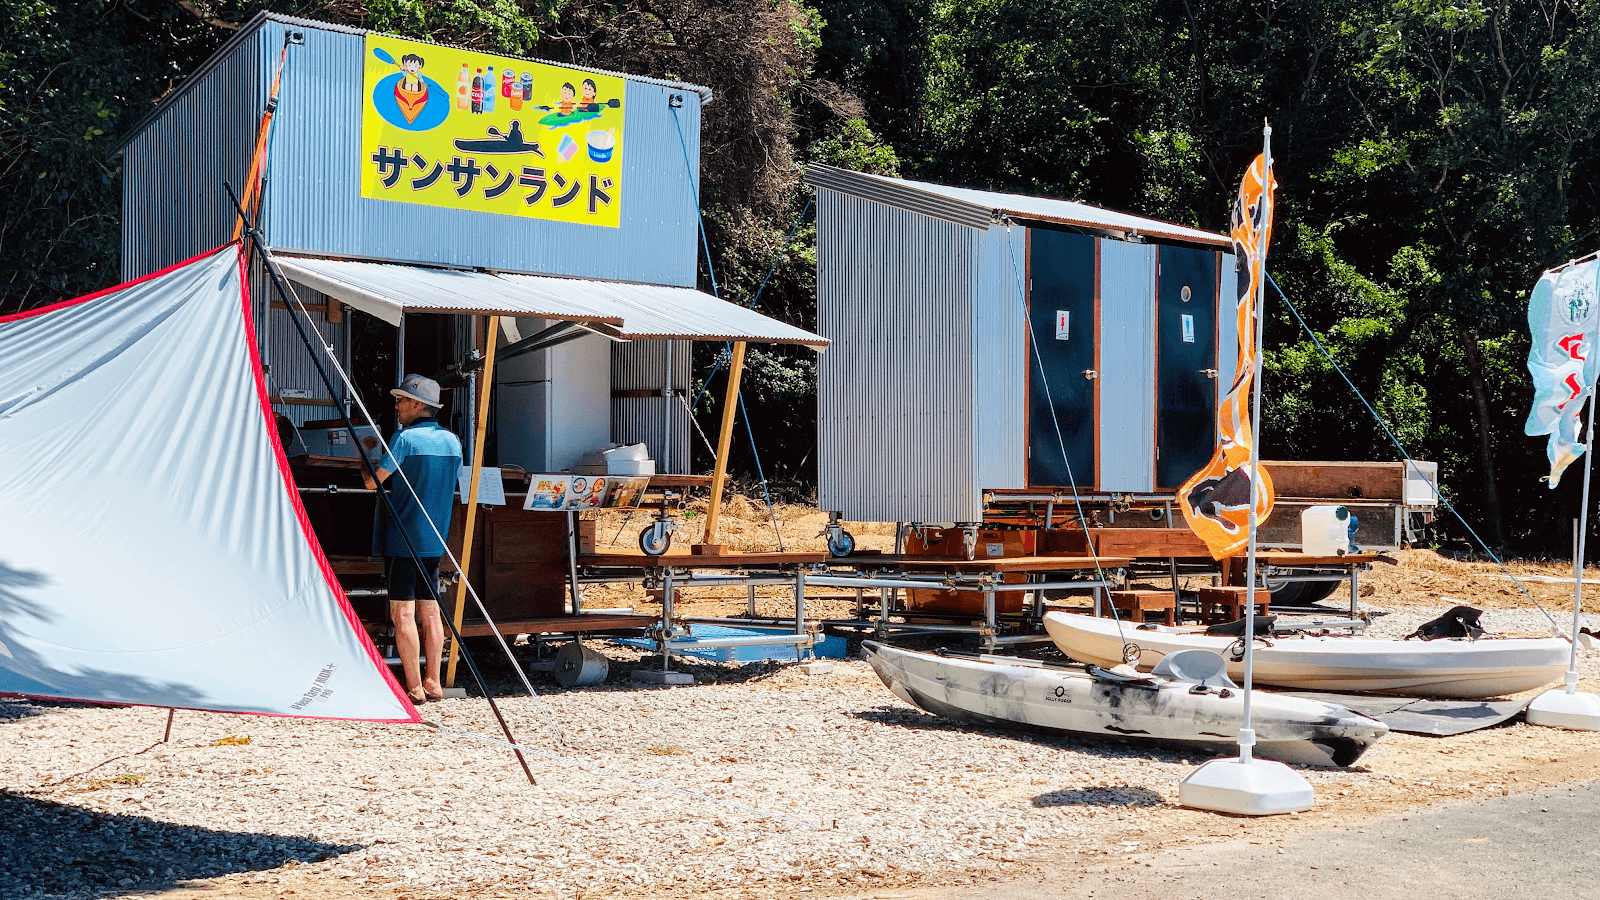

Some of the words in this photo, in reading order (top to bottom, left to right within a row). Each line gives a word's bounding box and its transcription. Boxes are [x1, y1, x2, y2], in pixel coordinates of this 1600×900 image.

[371, 146, 614, 214] サンサンランド
